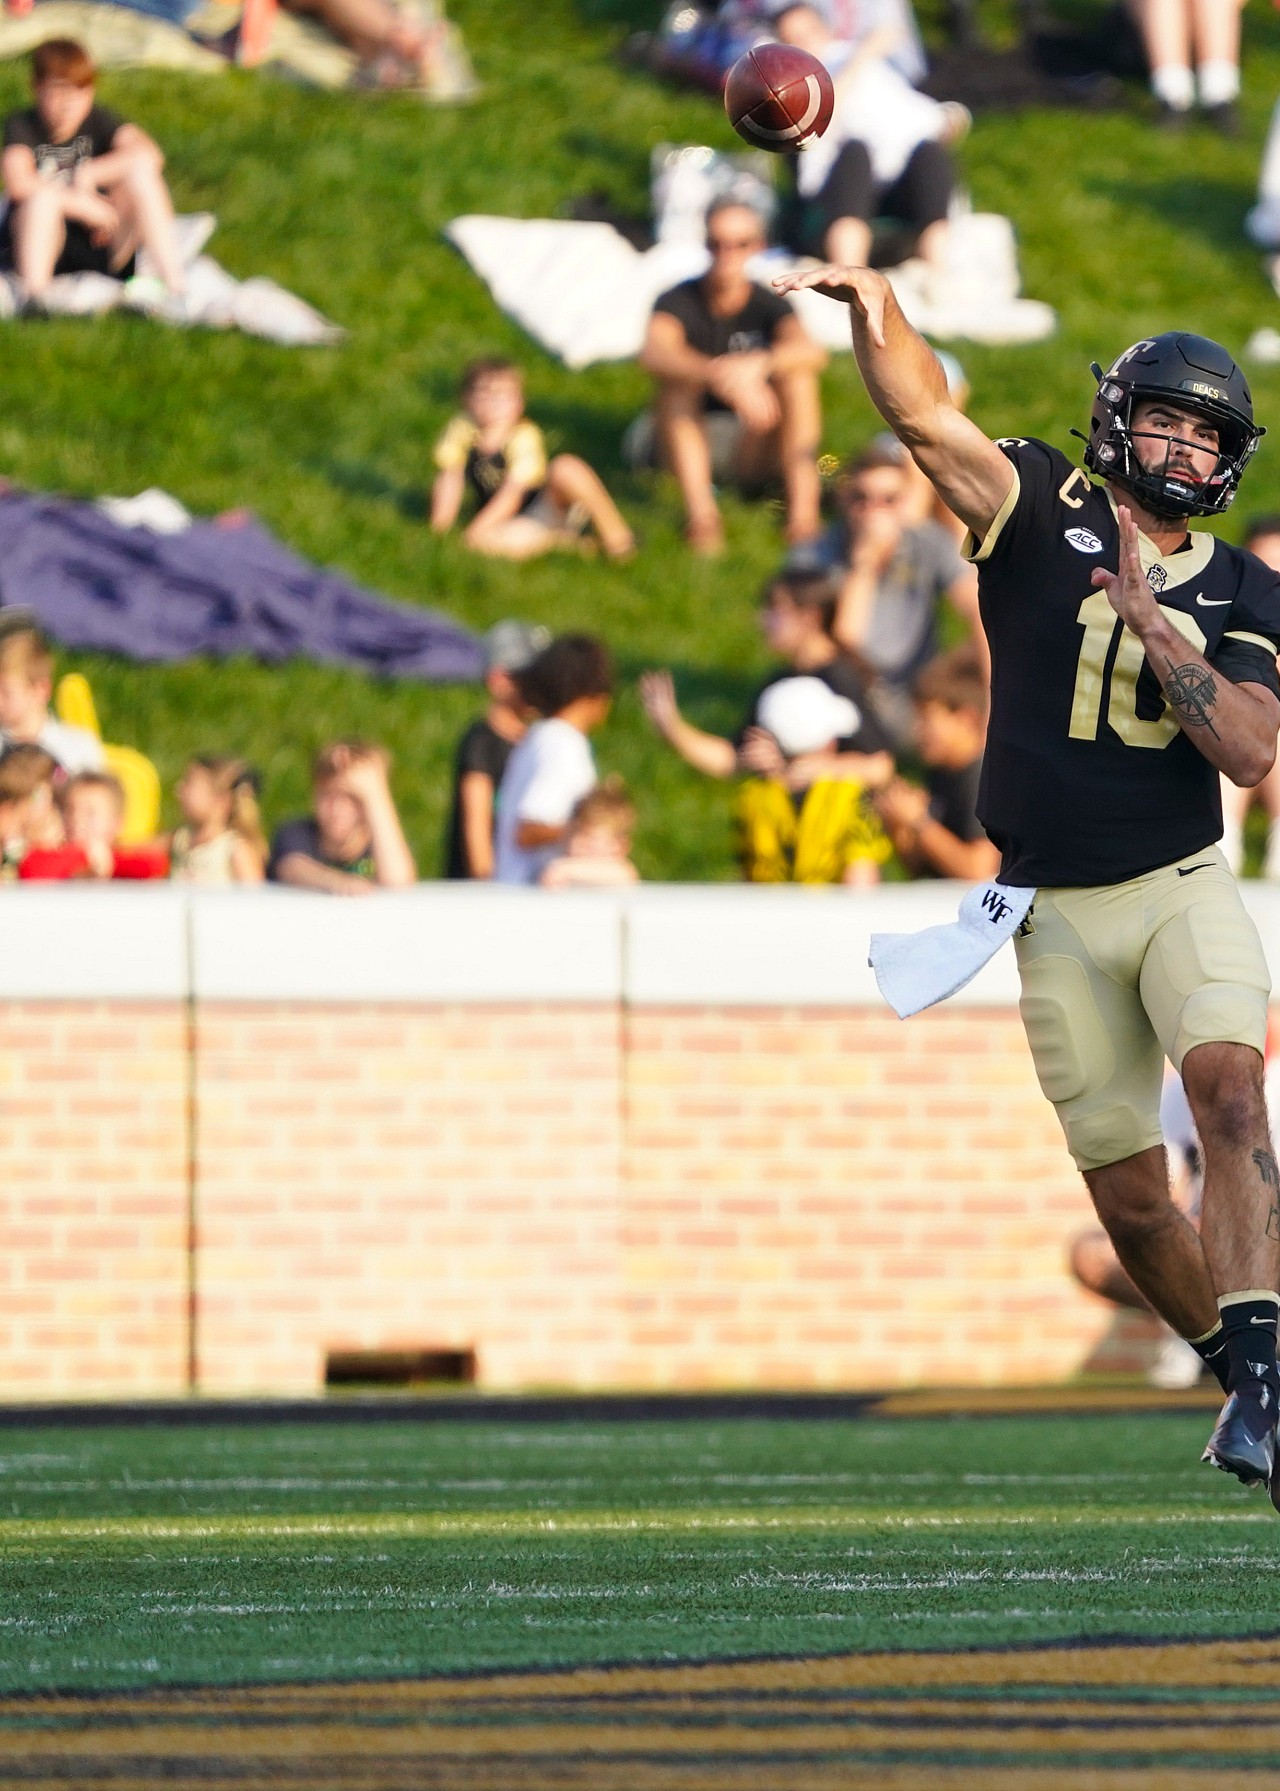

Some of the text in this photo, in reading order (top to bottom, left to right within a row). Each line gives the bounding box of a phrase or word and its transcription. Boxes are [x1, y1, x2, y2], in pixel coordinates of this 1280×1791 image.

[1192, 382, 1219, 399] DEACS
[1059, 468, 1091, 508] C
[1069, 531, 1099, 548] ACC
[1068, 589, 1207, 749] 10
[981, 889, 1013, 924] WF
